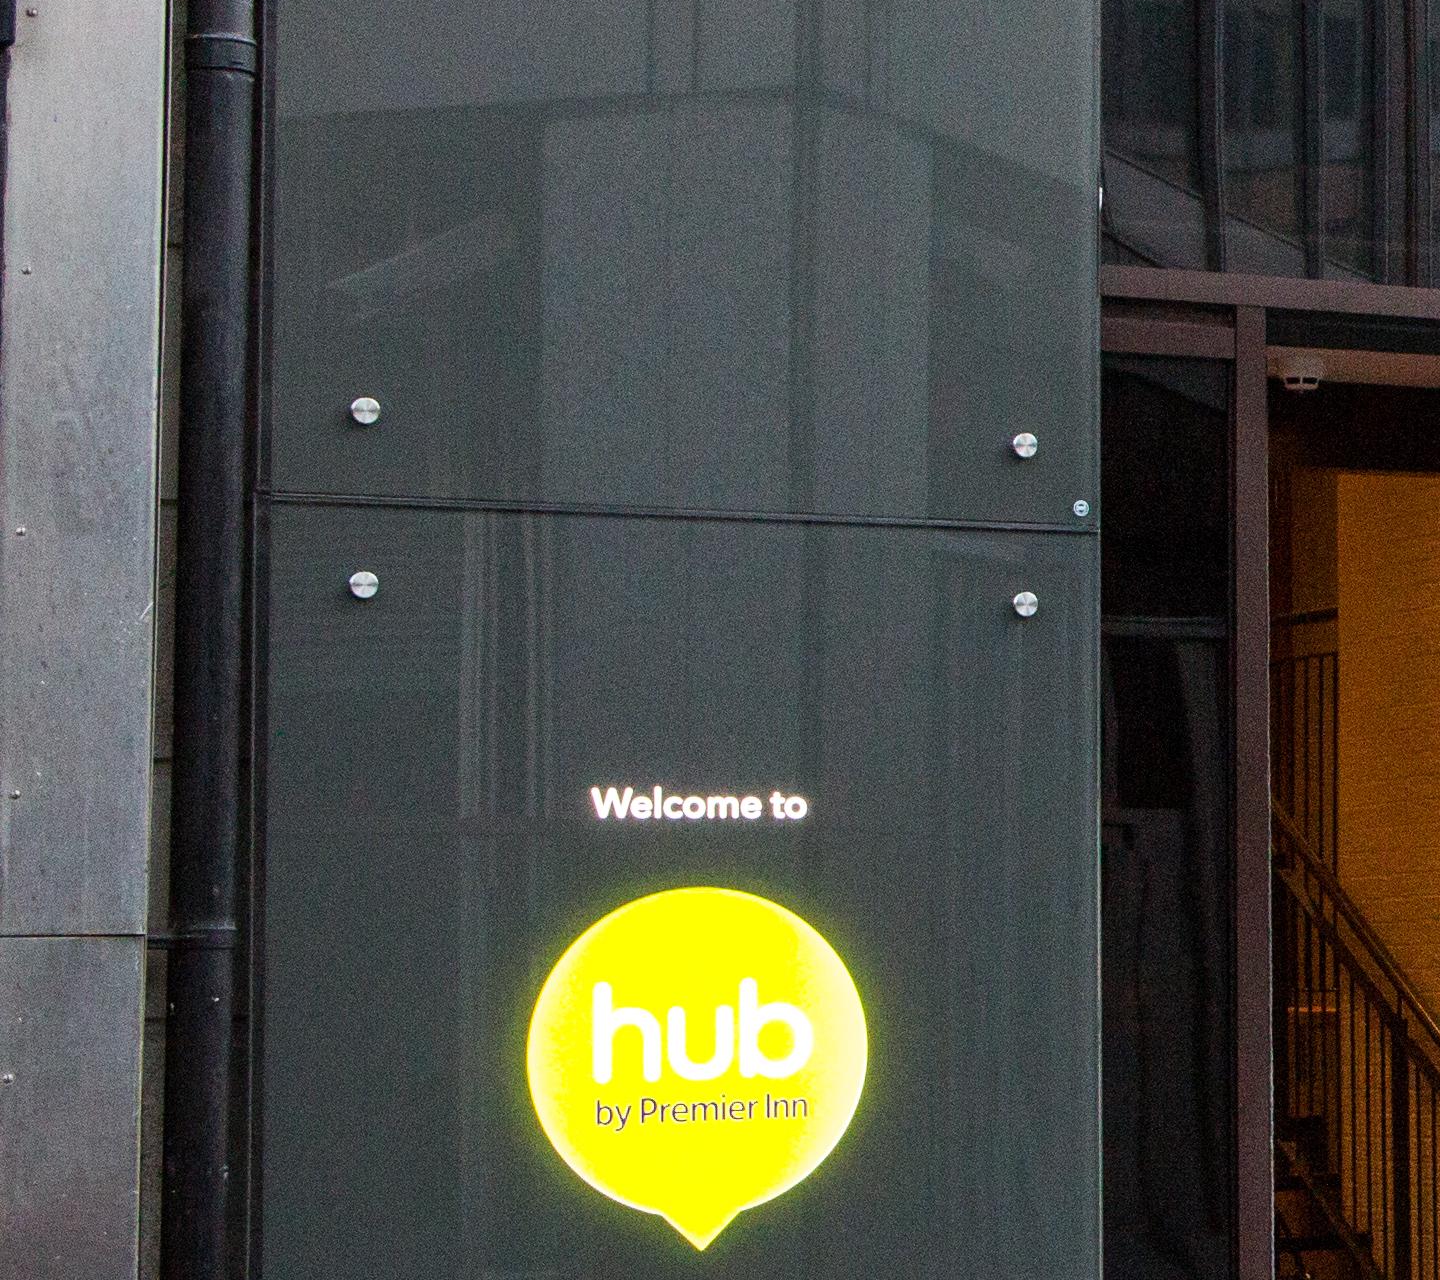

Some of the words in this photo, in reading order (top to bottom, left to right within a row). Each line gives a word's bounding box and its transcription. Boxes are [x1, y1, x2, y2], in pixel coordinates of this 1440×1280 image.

[590, 785, 764, 821] Welcome
[769, 789, 809, 821] to
[592, 977, 815, 1085] hub
[595, 1098, 632, 1132] by
[640, 1094, 759, 1124] Premier
[765, 1092, 809, 1119] Inn
